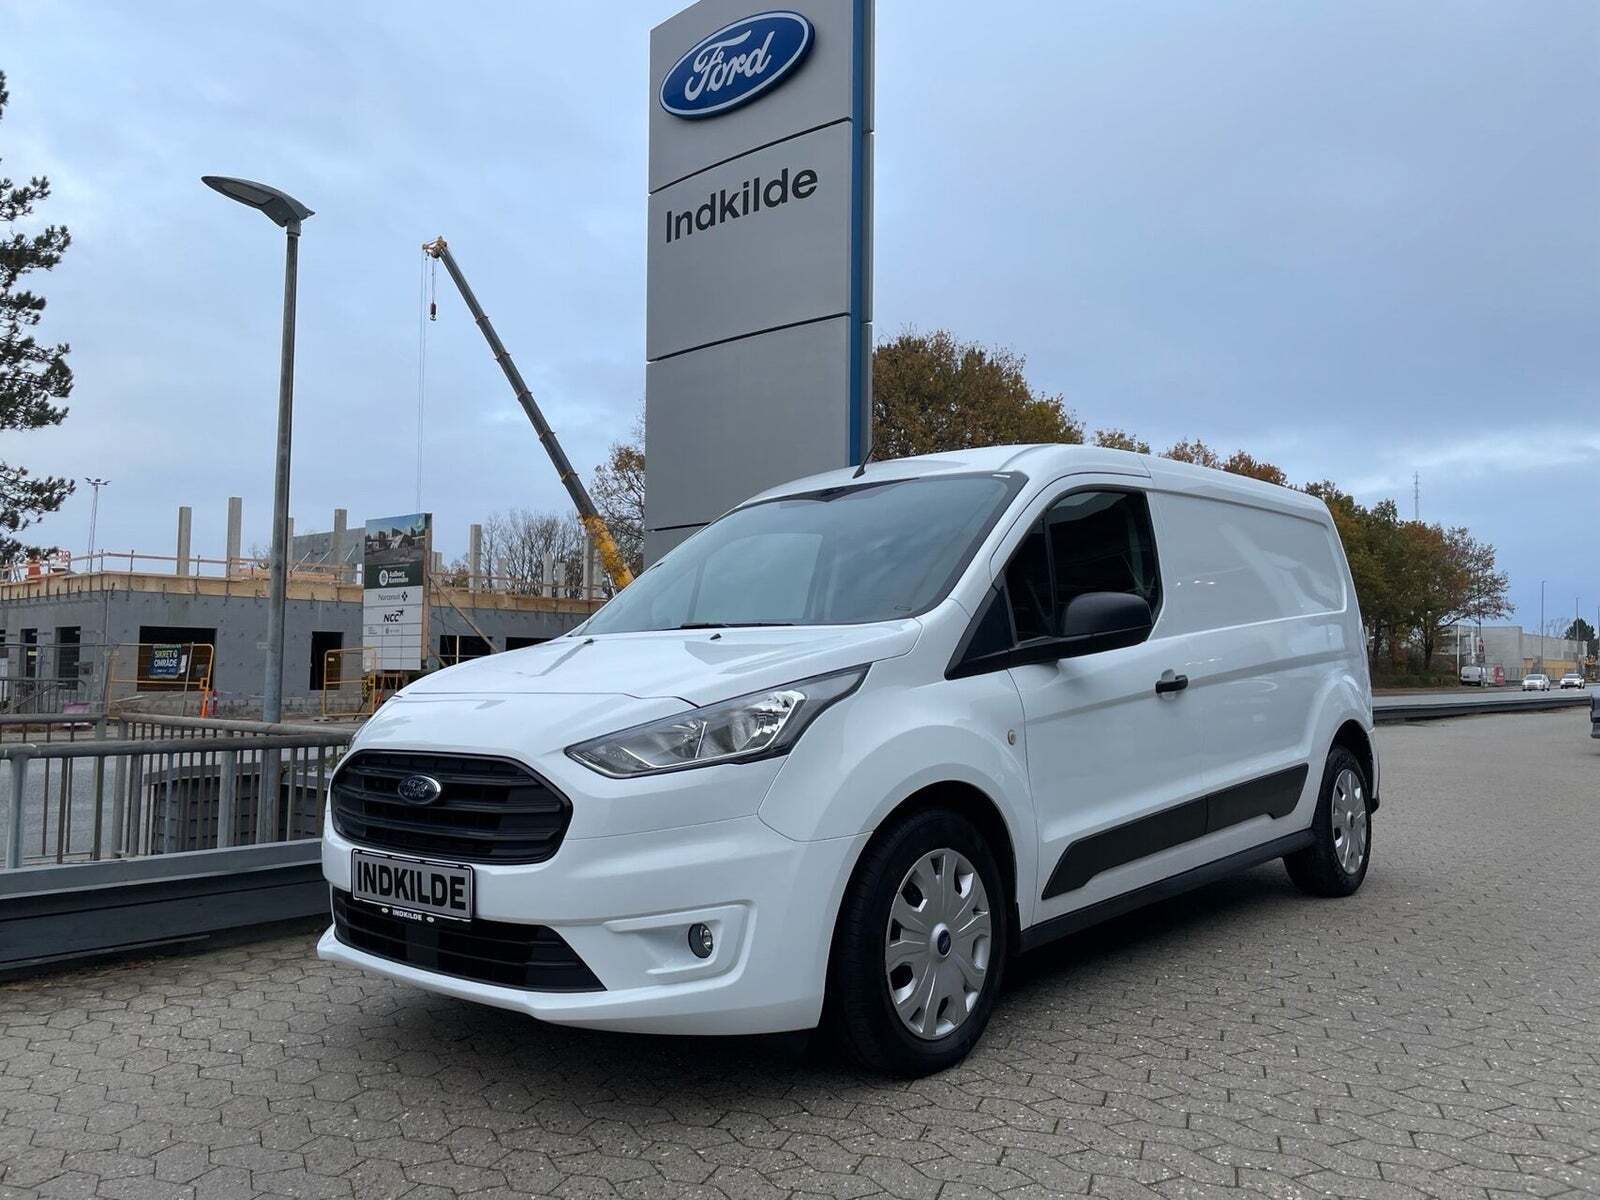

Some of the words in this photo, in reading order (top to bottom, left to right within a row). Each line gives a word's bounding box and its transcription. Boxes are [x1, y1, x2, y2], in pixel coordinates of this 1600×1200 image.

[684, 29, 776, 102] Ford
[666, 167, 819, 243] Indkilde
[384, 614, 399, 622] NCC
[357, 861, 467, 911] INDKILDE
[392, 910, 423, 921] INDKILDE
